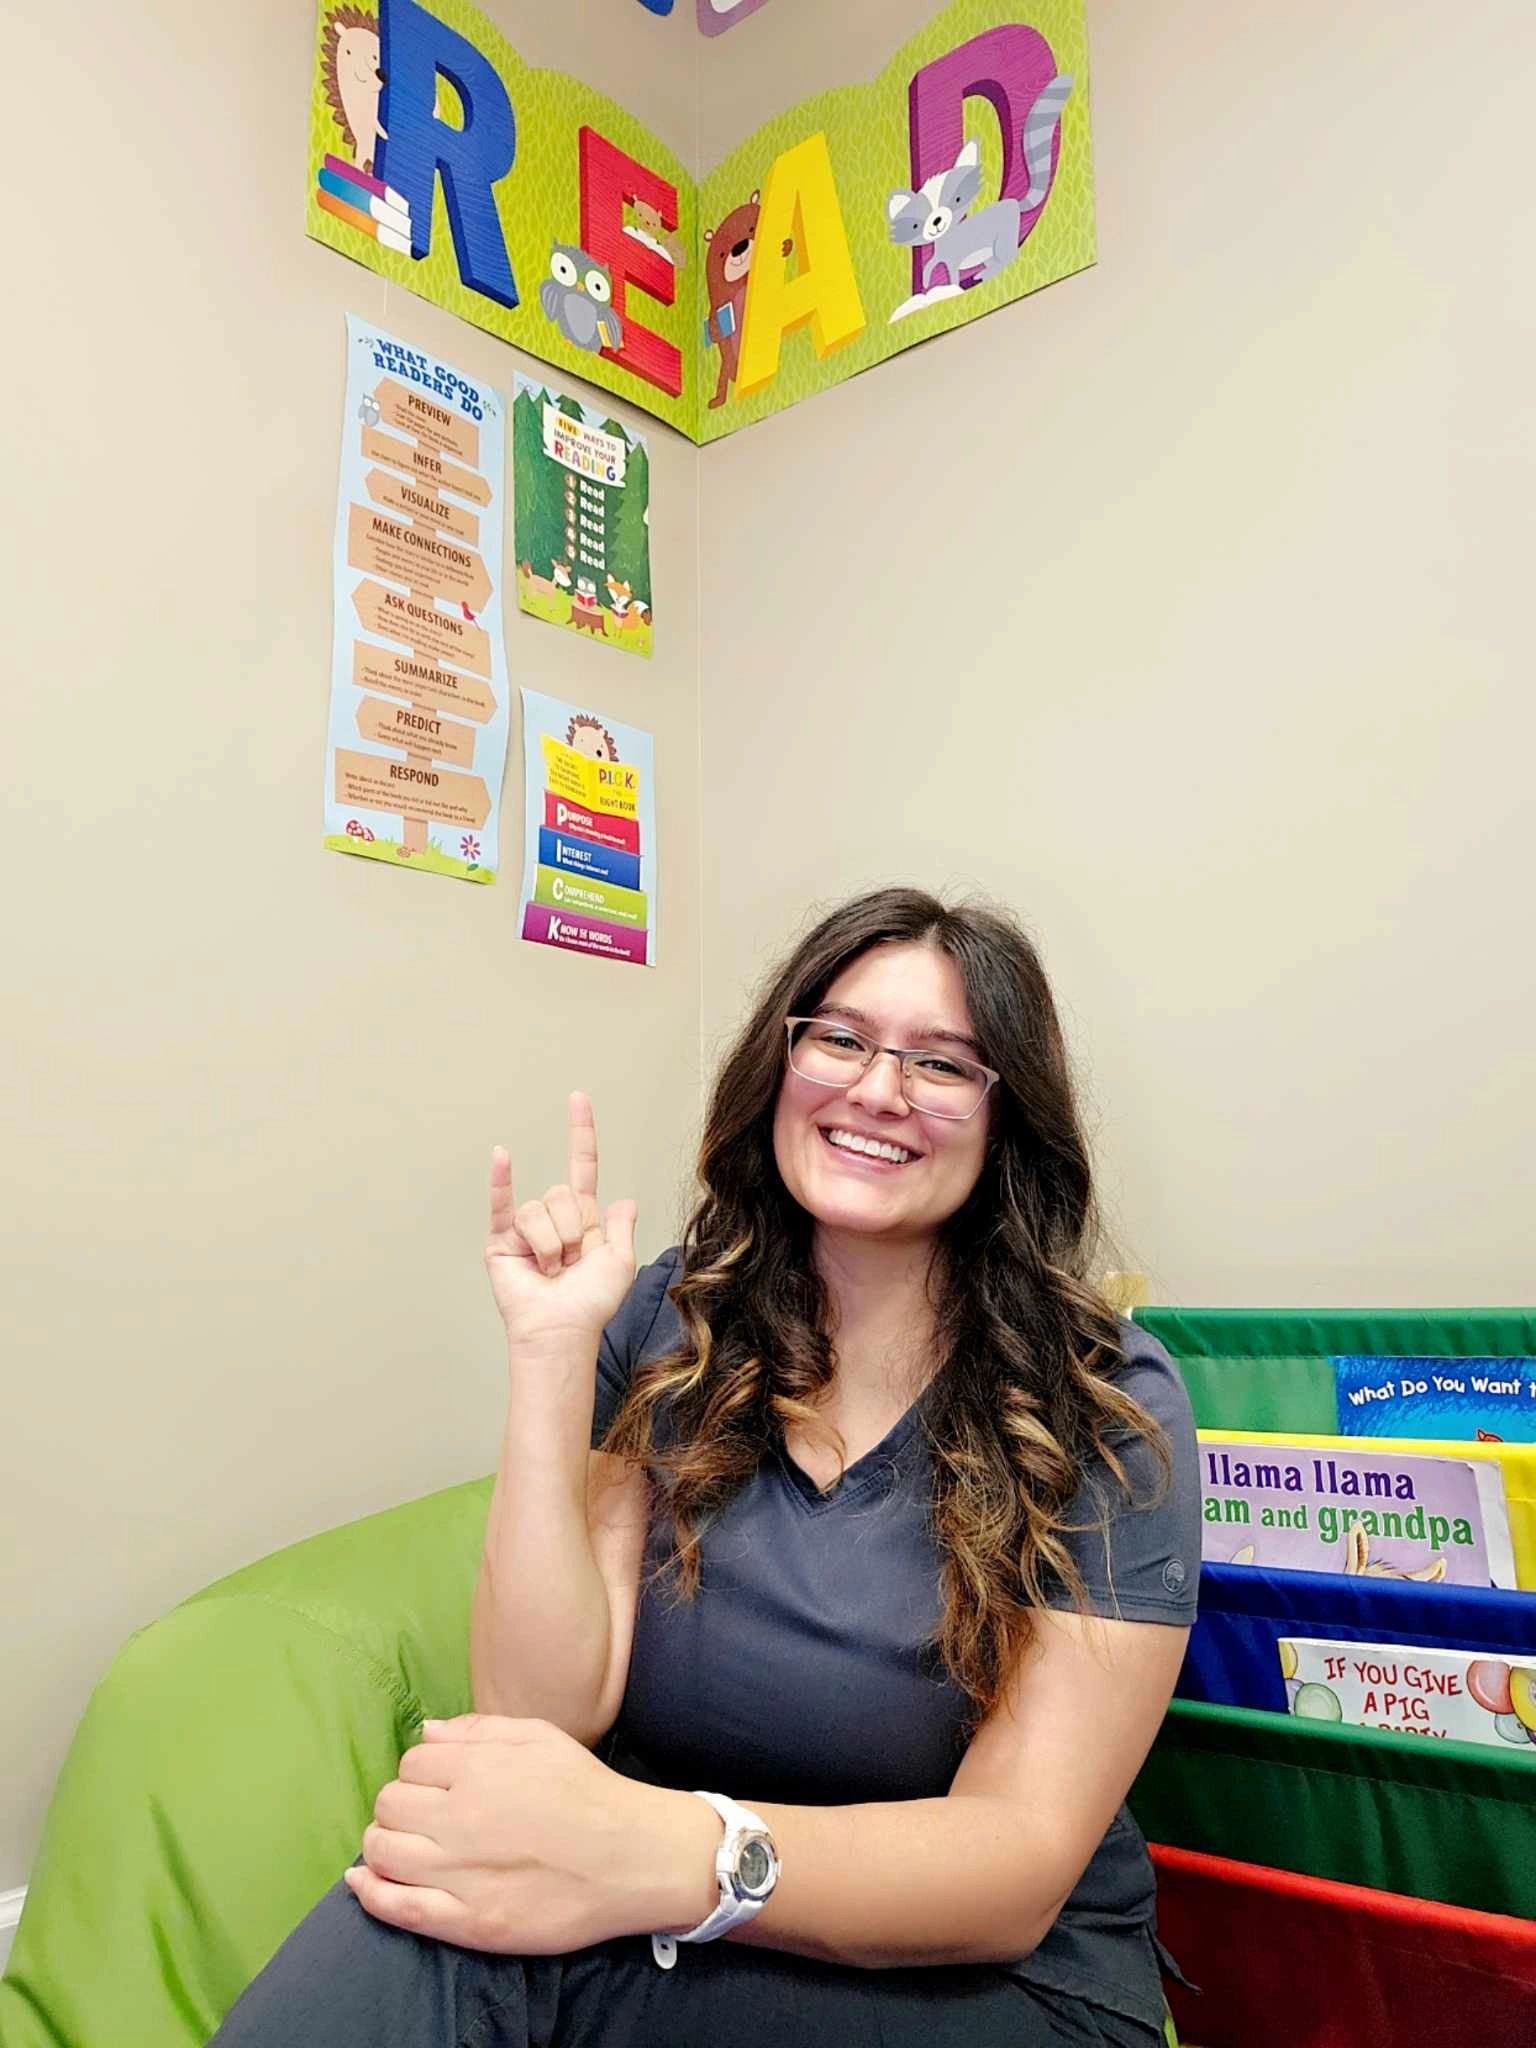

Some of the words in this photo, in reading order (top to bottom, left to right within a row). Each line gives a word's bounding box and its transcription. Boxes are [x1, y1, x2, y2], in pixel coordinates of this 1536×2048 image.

[376, 338, 427, 370] WHAT
[434, 365, 480, 403] GOOD
[373, 352, 453, 401] READERS
[461, 397, 483, 421] DO
[408, 395, 451, 427] PREVIEW
[413, 452, 442, 474] INFER
[554, 440, 616, 481] READING
[401, 486, 450, 520] VISUALIZE
[580, 480, 604, 501] Read
[580, 496, 604, 518] Read
[580, 513, 604, 535] Read
[372, 518, 402, 540] MAKE
[404, 531, 471, 568] CONNECTIONS
[580, 532, 604, 553] Read
[580, 550, 604, 570] Read
[385, 593, 405, 611] ASK
[407, 603, 463, 636] QUESTIONS
[394, 659, 458, 689] SUMMARIZE
[396, 710, 442, 735] PREDICT
[390, 765, 439, 787] RESPOND
[557, 803, 593, 827] PURPOSE
[556, 839, 592, 863] INTEREST
[552, 877, 605, 904] COMPREHEND
[548, 915, 579, 940] KNOW
[588, 930, 613, 945] WORDS
[1348, 1381, 1395, 1407] What
[1400, 1379, 1429, 1397] Do
[1432, 1375, 1465, 1394] You
[1471, 1375, 1521, 1396] Want
[1207, 1453, 1303, 1492] llama
[1313, 1460, 1416, 1500] llama
[1261, 1505, 1308, 1529] and
[1318, 1506, 1474, 1550] grandpa
[1324, 1657, 1346, 1680] IF
[1354, 1661, 1398, 1685] YOU
[1404, 1665, 1463, 1696] GIVE
[1363, 1691, 1377, 1713] A
[1384, 1693, 1430, 1721] PIG
